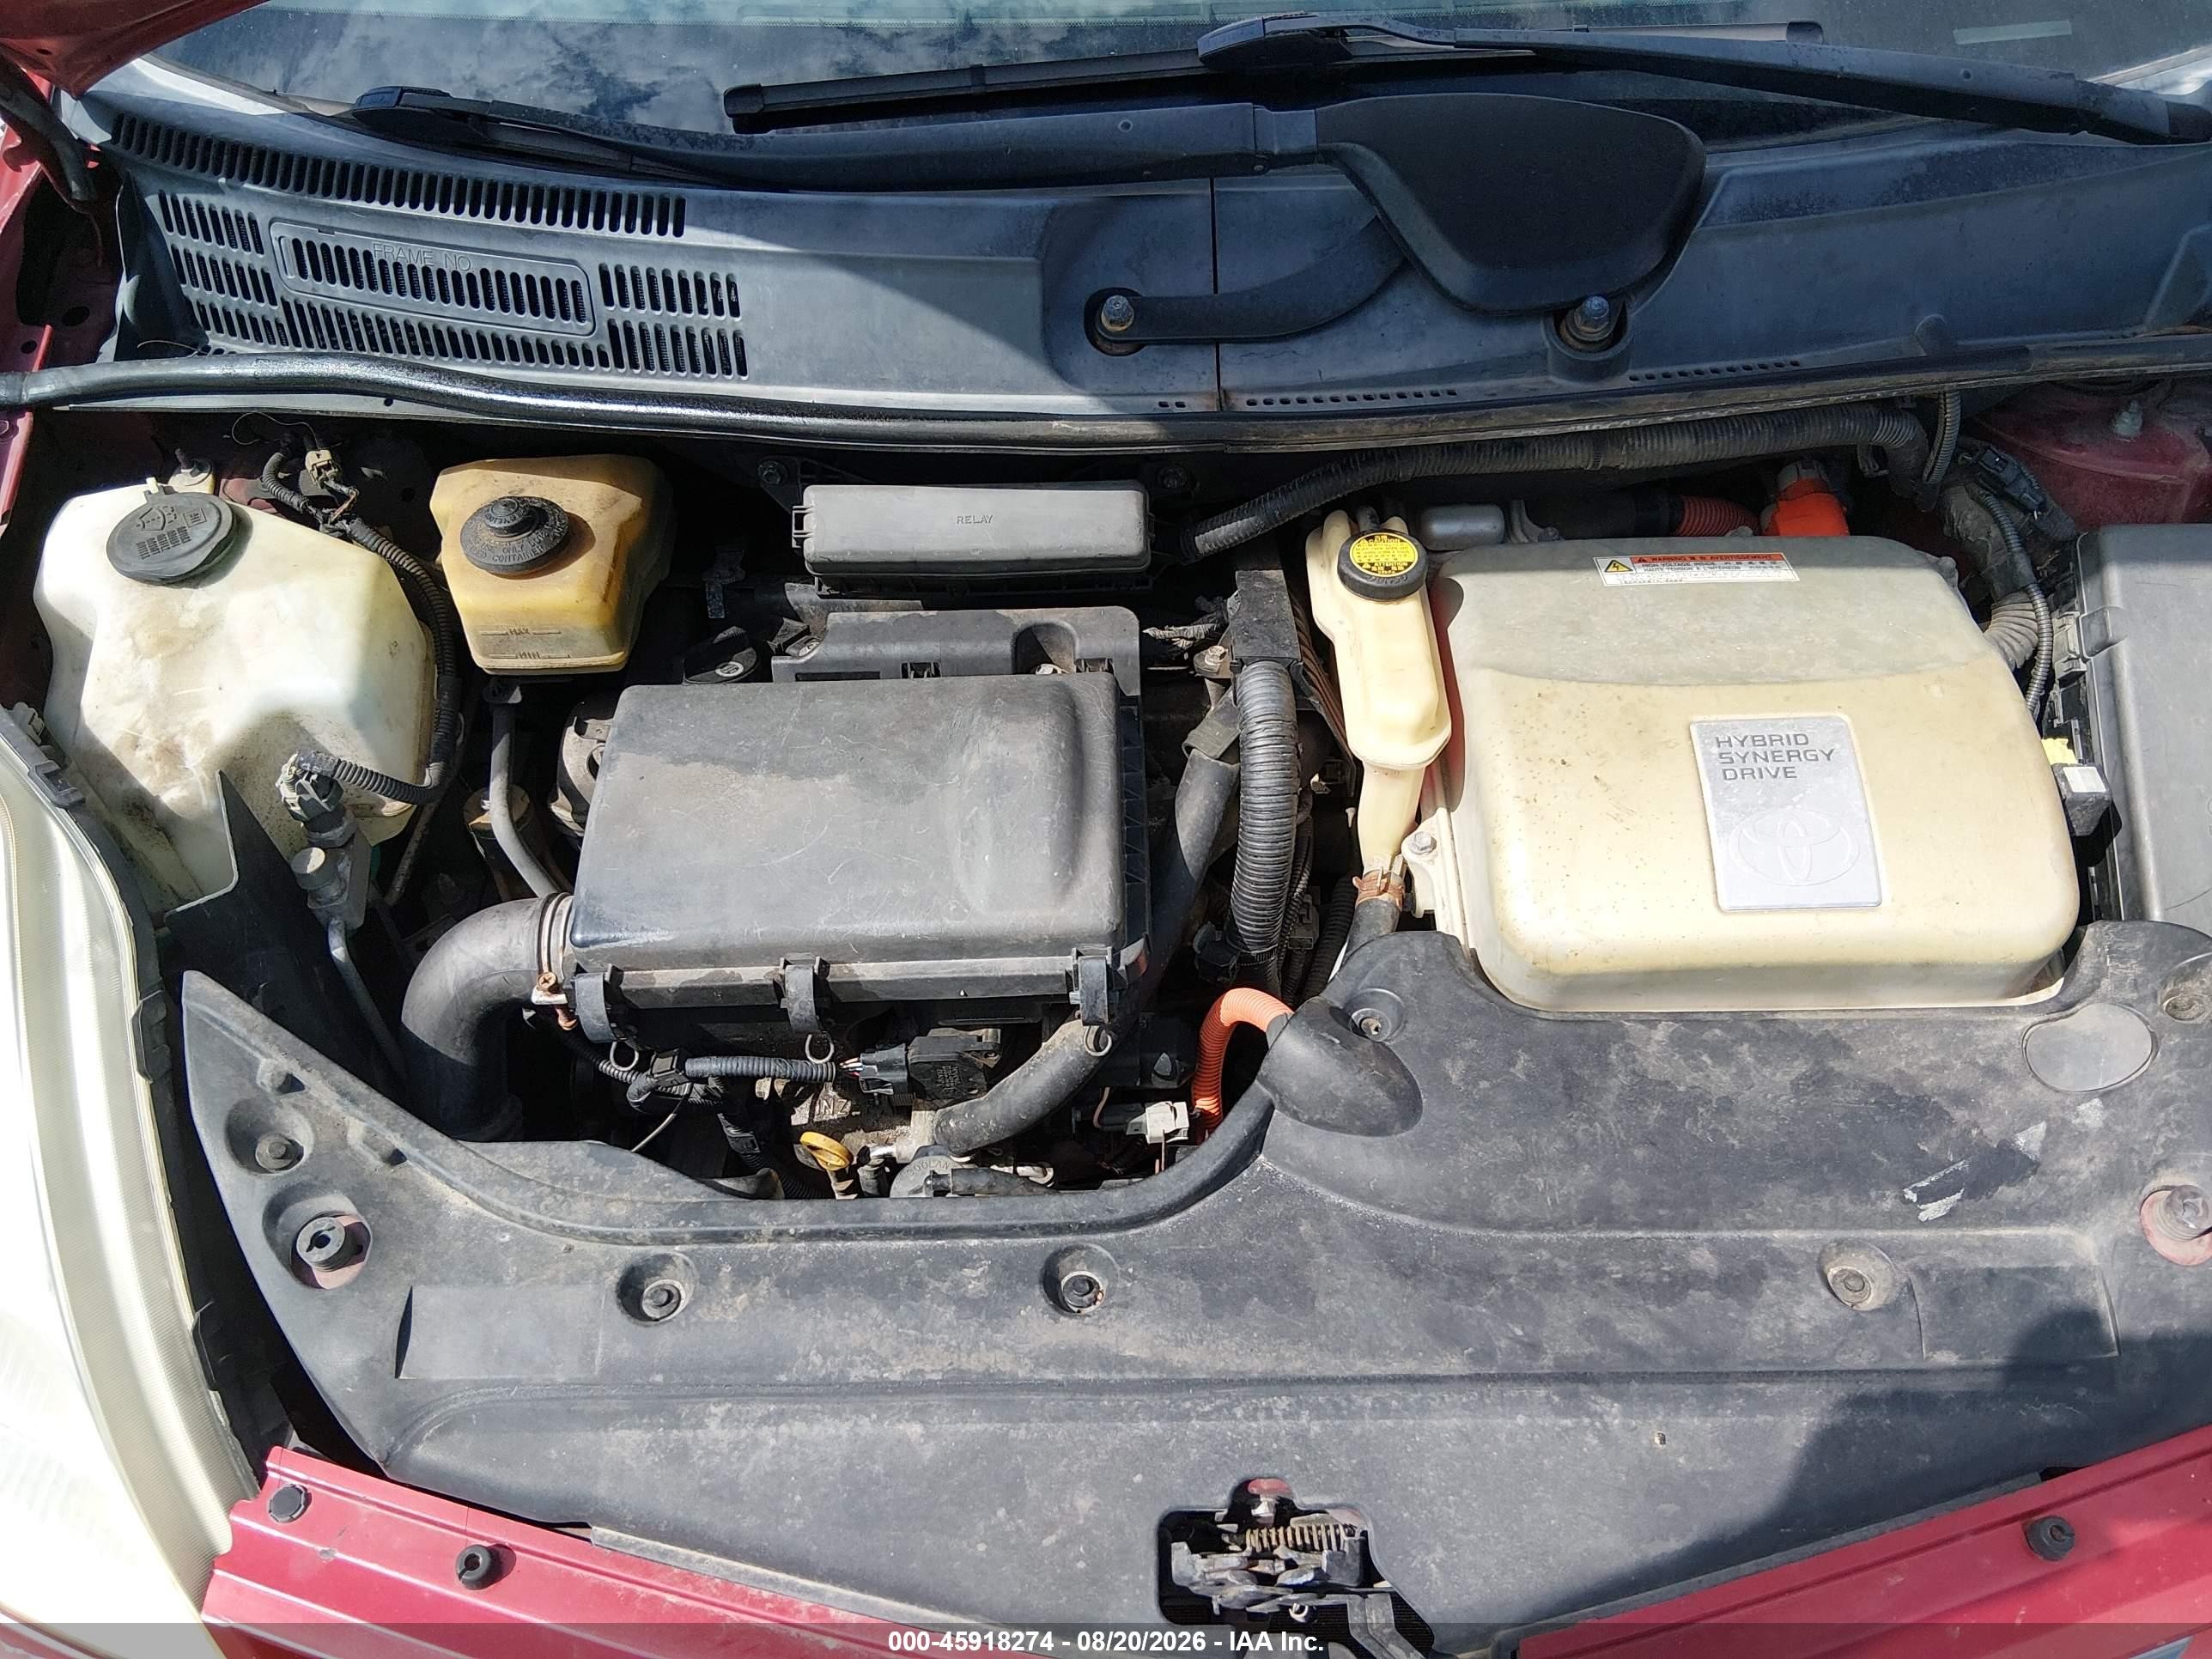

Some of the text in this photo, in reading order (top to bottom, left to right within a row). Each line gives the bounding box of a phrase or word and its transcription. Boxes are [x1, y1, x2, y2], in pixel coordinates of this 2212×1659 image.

[373, 243, 434, 266] FRAME
[957, 514, 994, 524] RELAY
[492, 544, 544, 563] CONTAINER
[1715, 733, 1809, 748] HYBRID
[1718, 749, 1835, 764] SYNERGY
[1722, 766, 1797, 781] DRIVE
